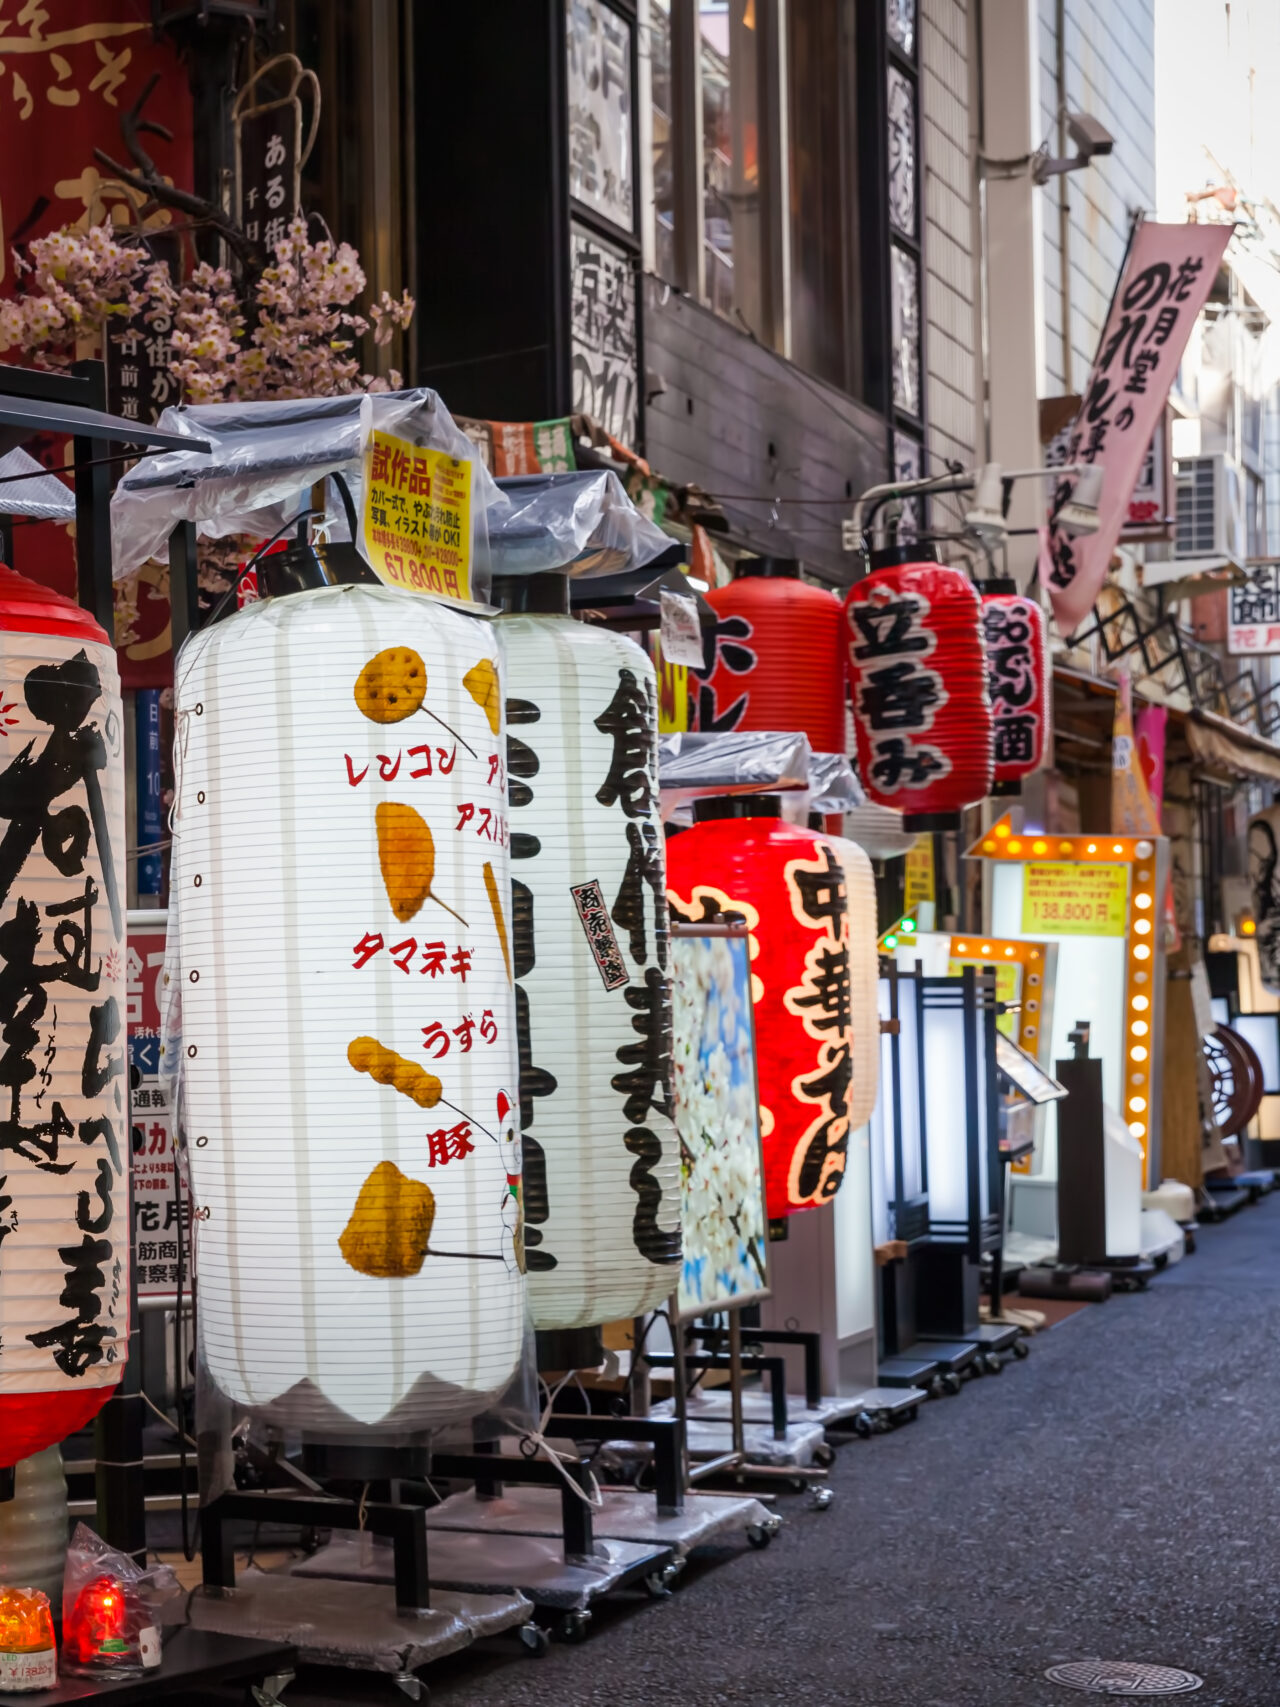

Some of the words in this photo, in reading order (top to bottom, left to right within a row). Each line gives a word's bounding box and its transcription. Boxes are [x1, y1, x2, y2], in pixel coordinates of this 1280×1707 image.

[371, 442, 431, 497] 試作品
[851, 594, 947, 789] 立呑み
[344, 742, 457, 787] レンコン
[352, 931, 474, 983] タマネギ
[422, 1009, 498, 1059] うずら
[427, 1121, 475, 1167] 豚
